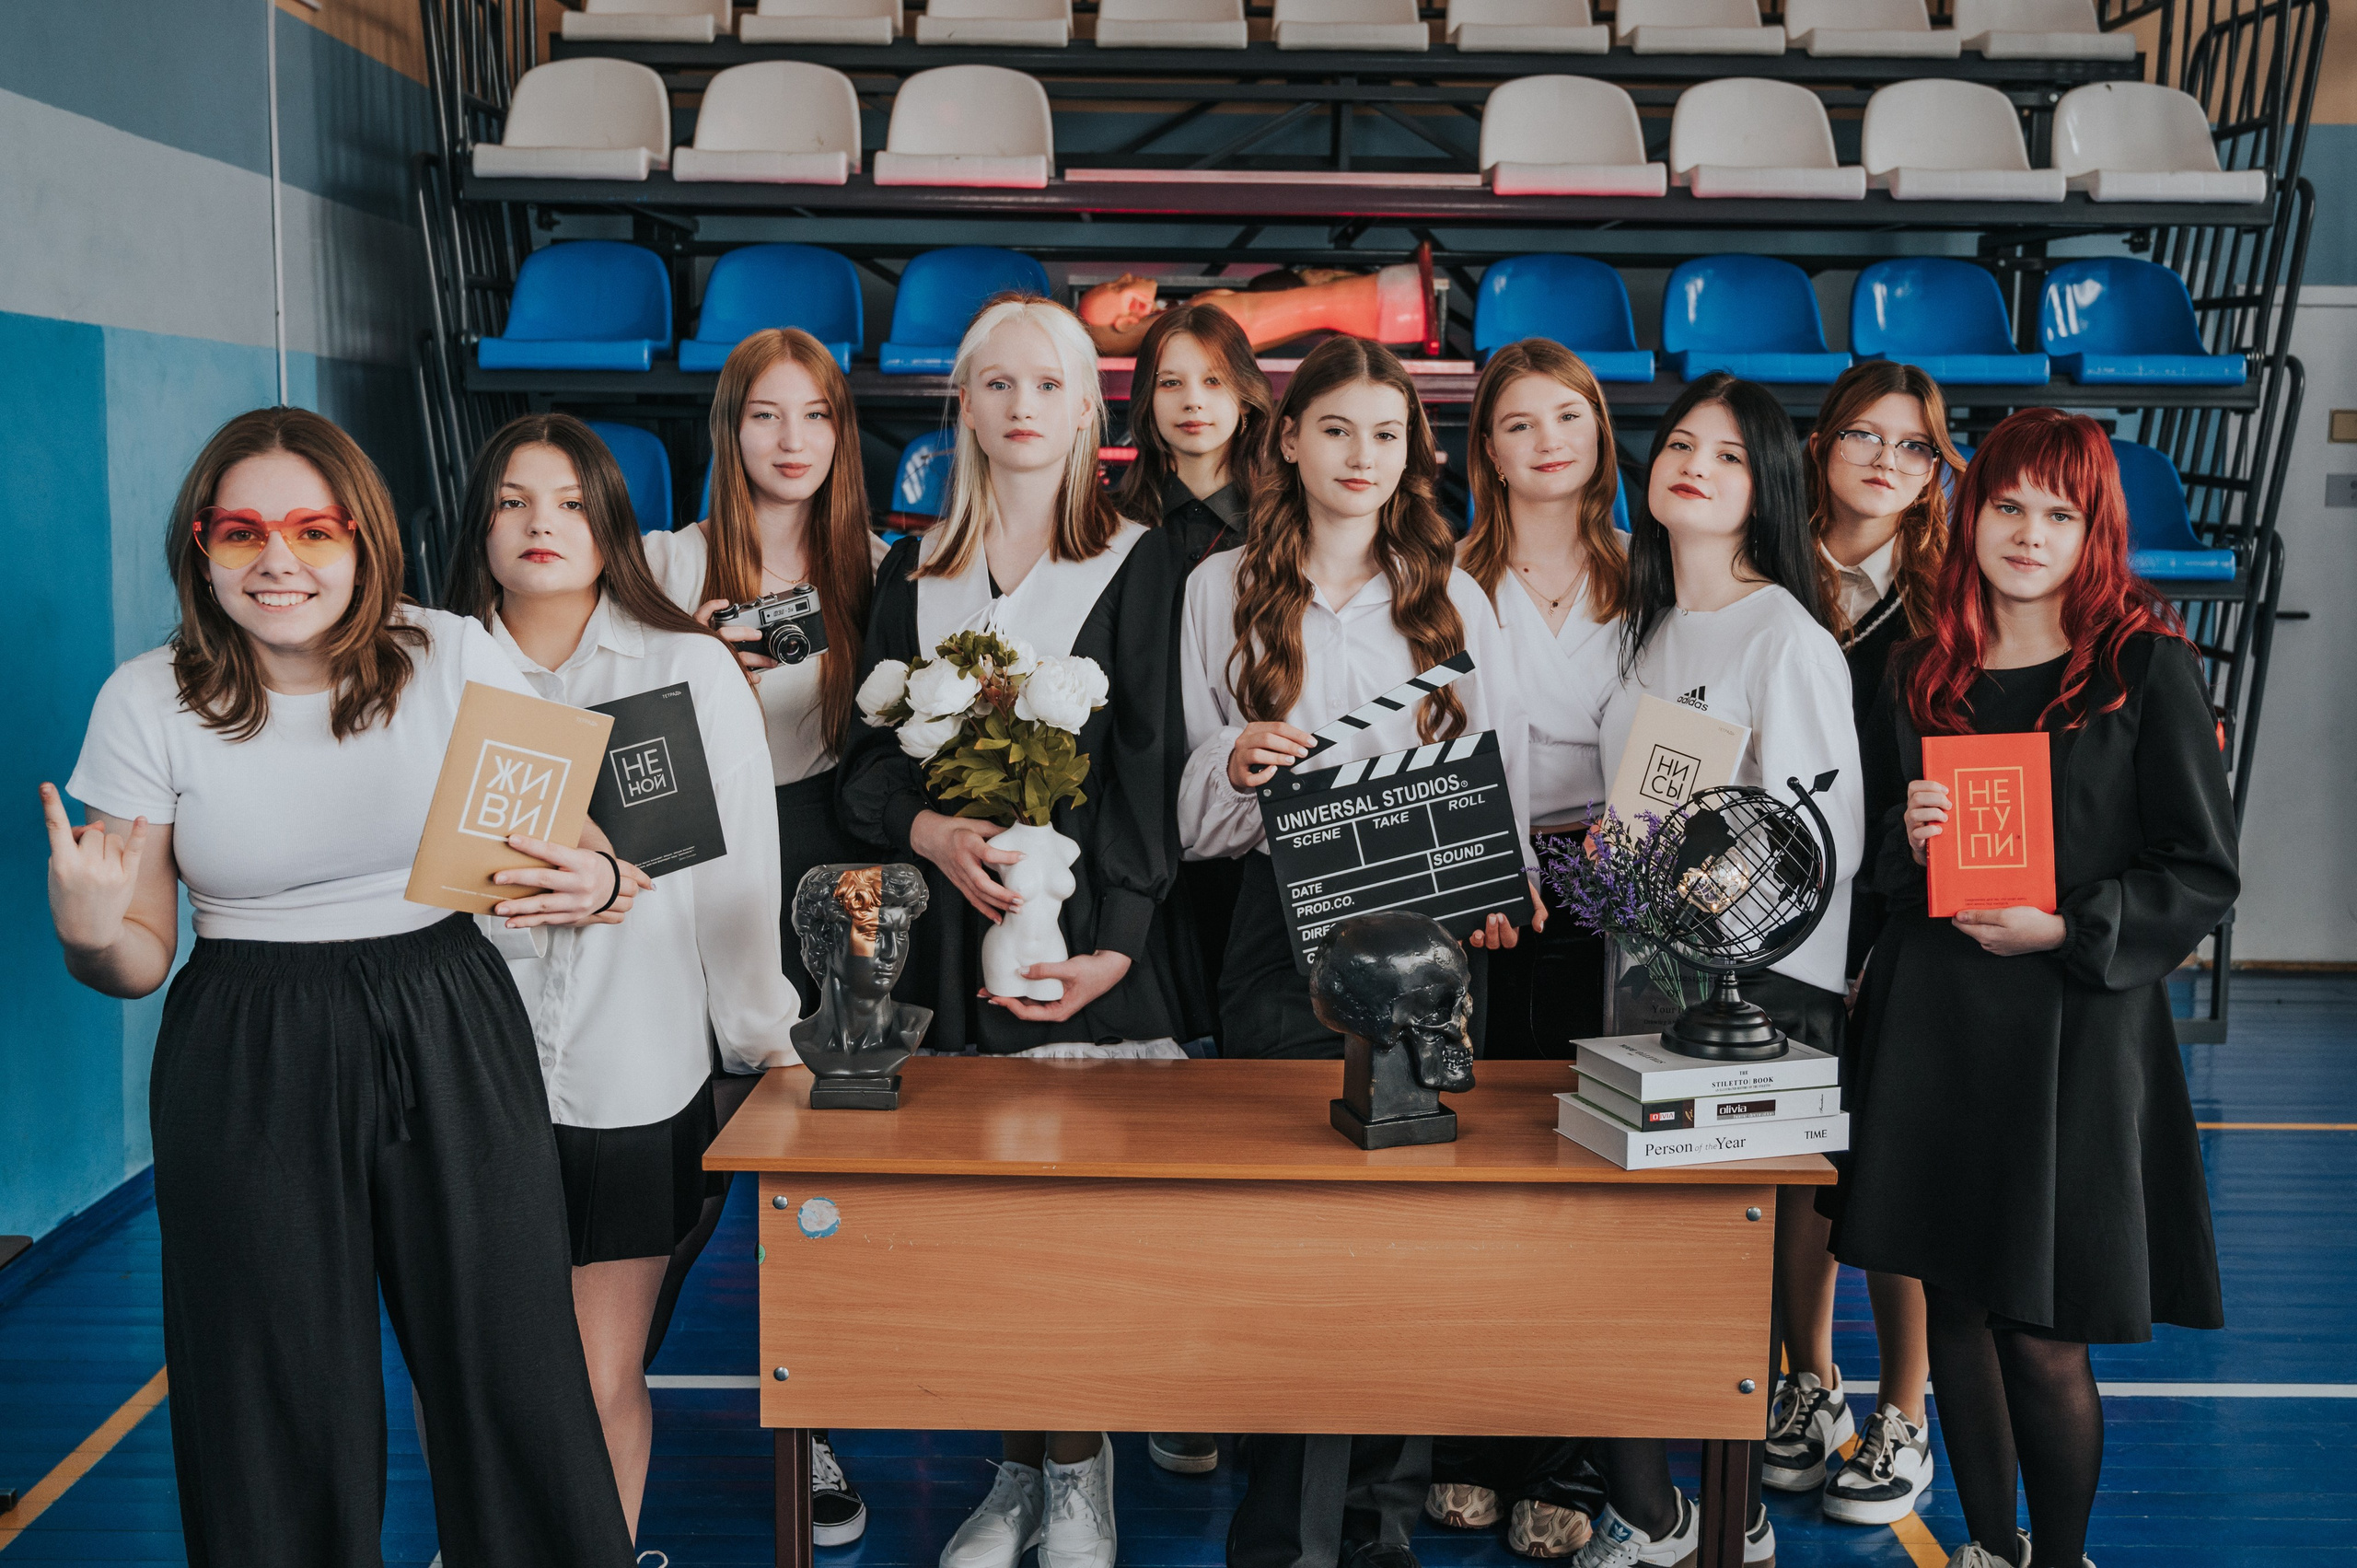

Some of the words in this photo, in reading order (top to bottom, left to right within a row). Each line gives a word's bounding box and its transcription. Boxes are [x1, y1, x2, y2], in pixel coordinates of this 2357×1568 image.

[662, 691, 682, 699] ТЕТРАДЬ
[1677, 695, 1709, 712] adidas
[621, 749, 663, 781] НЕ
[1656, 755, 1689, 782] НИ
[486, 755, 553, 800] ЖИ
[628, 773, 668, 797] НОЙ
[1651, 774, 1684, 801] СЫ
[1448, 794, 1486, 811] ROLL
[1968, 779, 2011, 805] НЕ
[477, 793, 542, 836] ВИ
[1276, 795, 1378, 832] UNIVERSAL
[1372, 811, 1410, 830] TAKE
[1969, 806, 2011, 831] ТУ
[1293, 827, 1341, 849] SCENE
[1970, 832, 2014, 858] ПИ
[1433, 843, 1485, 866] SOUND
[1291, 882, 1323, 900] DATE
[1296, 895, 1355, 918] PROD.CO.
[1302, 923, 1336, 941] DIRE
[1652, 1005, 1677, 1014] Your
[1712, 1078, 1748, 1087] STILETTO
[1752, 1076, 1774, 1085] BOOK
[1719, 1104, 1747, 1115] olivia
[1804, 1129, 1828, 1140] TIME
[1644, 1143, 1693, 1156] Person
[1694, 1144, 1703, 1154] of
[1705, 1143, 1718, 1151] the
[1715, 1137, 1747, 1150] Year
